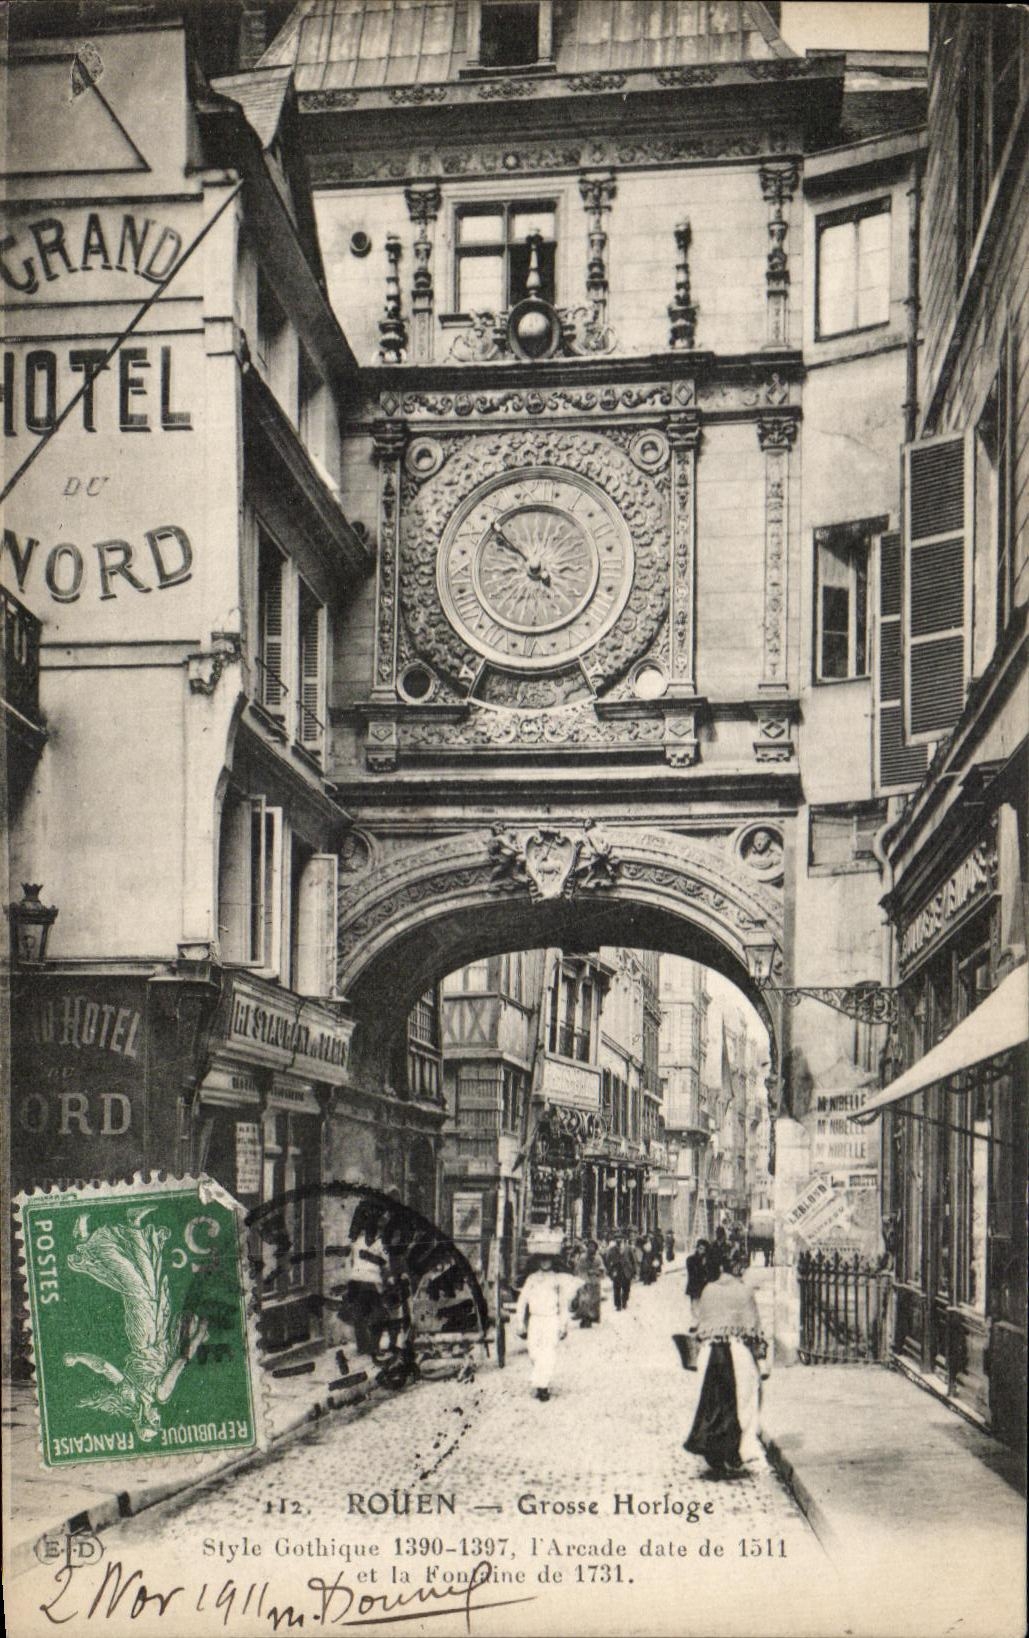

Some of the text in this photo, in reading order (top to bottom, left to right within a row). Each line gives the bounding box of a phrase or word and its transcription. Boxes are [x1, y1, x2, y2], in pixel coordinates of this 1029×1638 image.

[0, 213, 182, 294] GRAND
[3, 525, 193, 604] NORD
[34, 1219, 59, 1305] POSTES
[53, 1420, 249, 1457] REPUBLIQUE FRANÇAISE
[40, 1566, 79, 1624] 2
[195, 1579, 270, 1626] 1911
